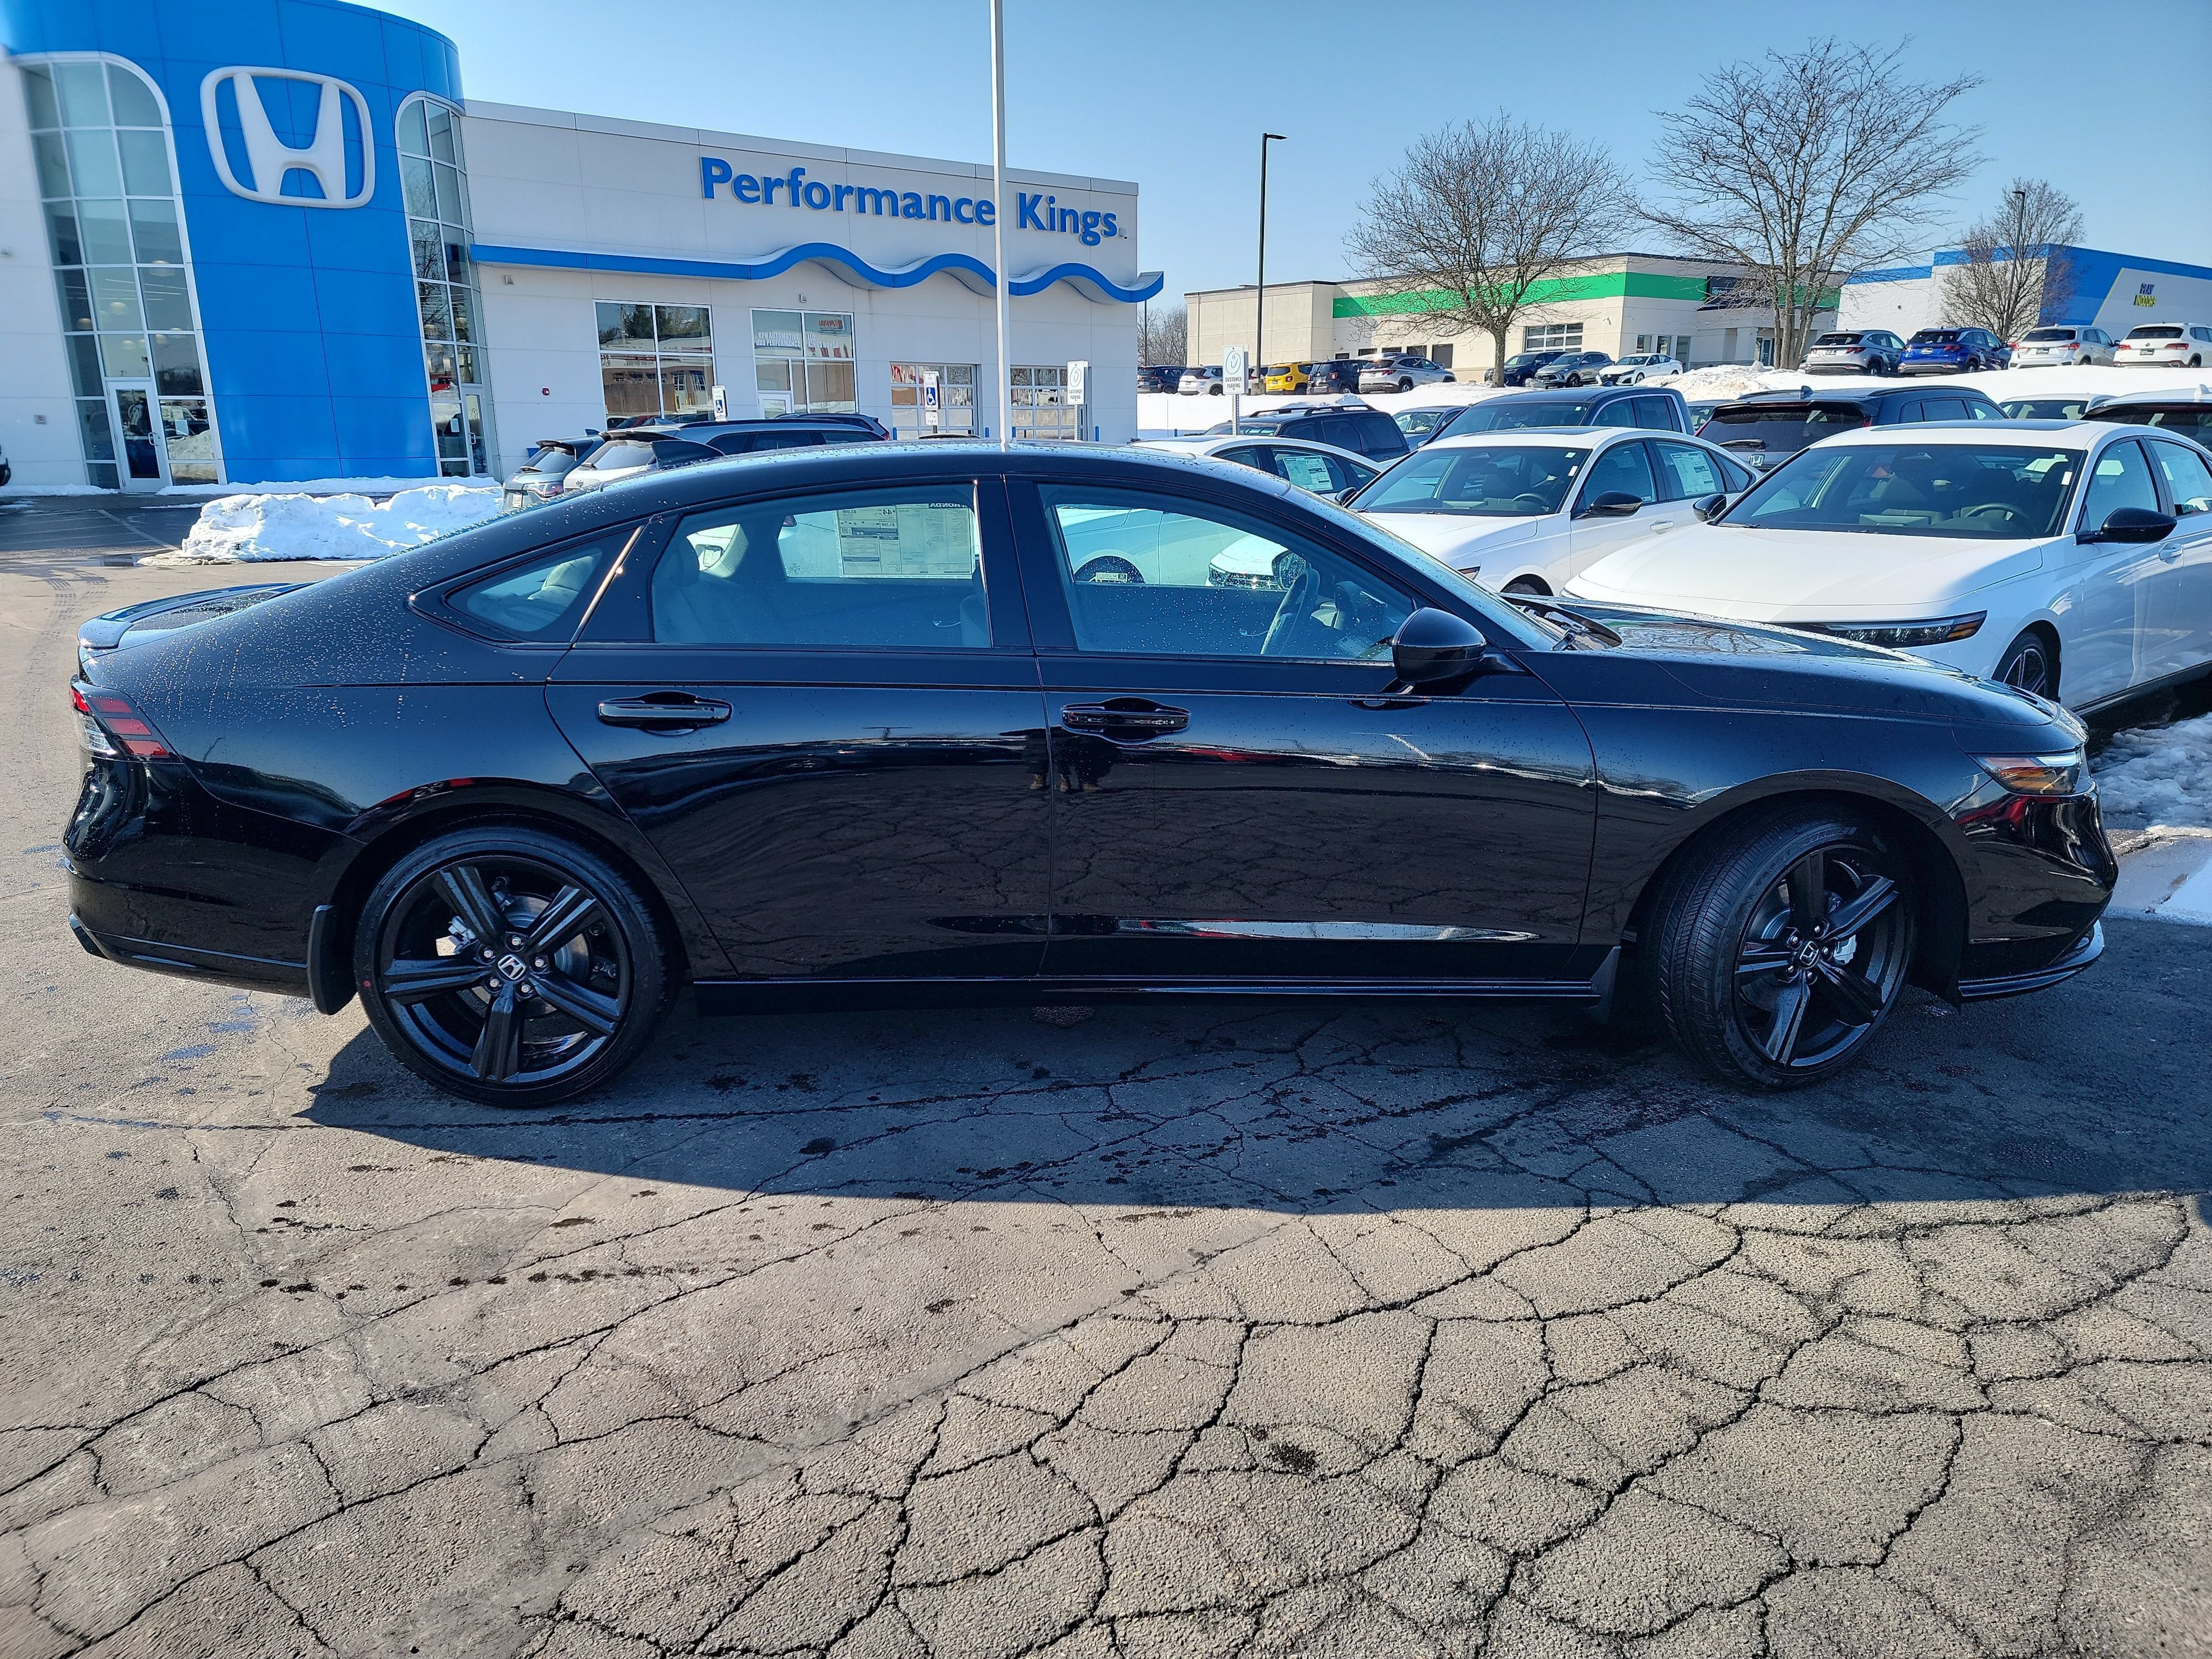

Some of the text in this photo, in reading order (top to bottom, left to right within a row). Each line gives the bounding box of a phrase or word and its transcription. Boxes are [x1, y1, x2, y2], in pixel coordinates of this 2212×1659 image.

[701, 157, 1118, 246] Performance Kings
[769, 332, 799, 340] AUTOMOTIVE
[766, 339, 800, 347] PERFORMANCE
